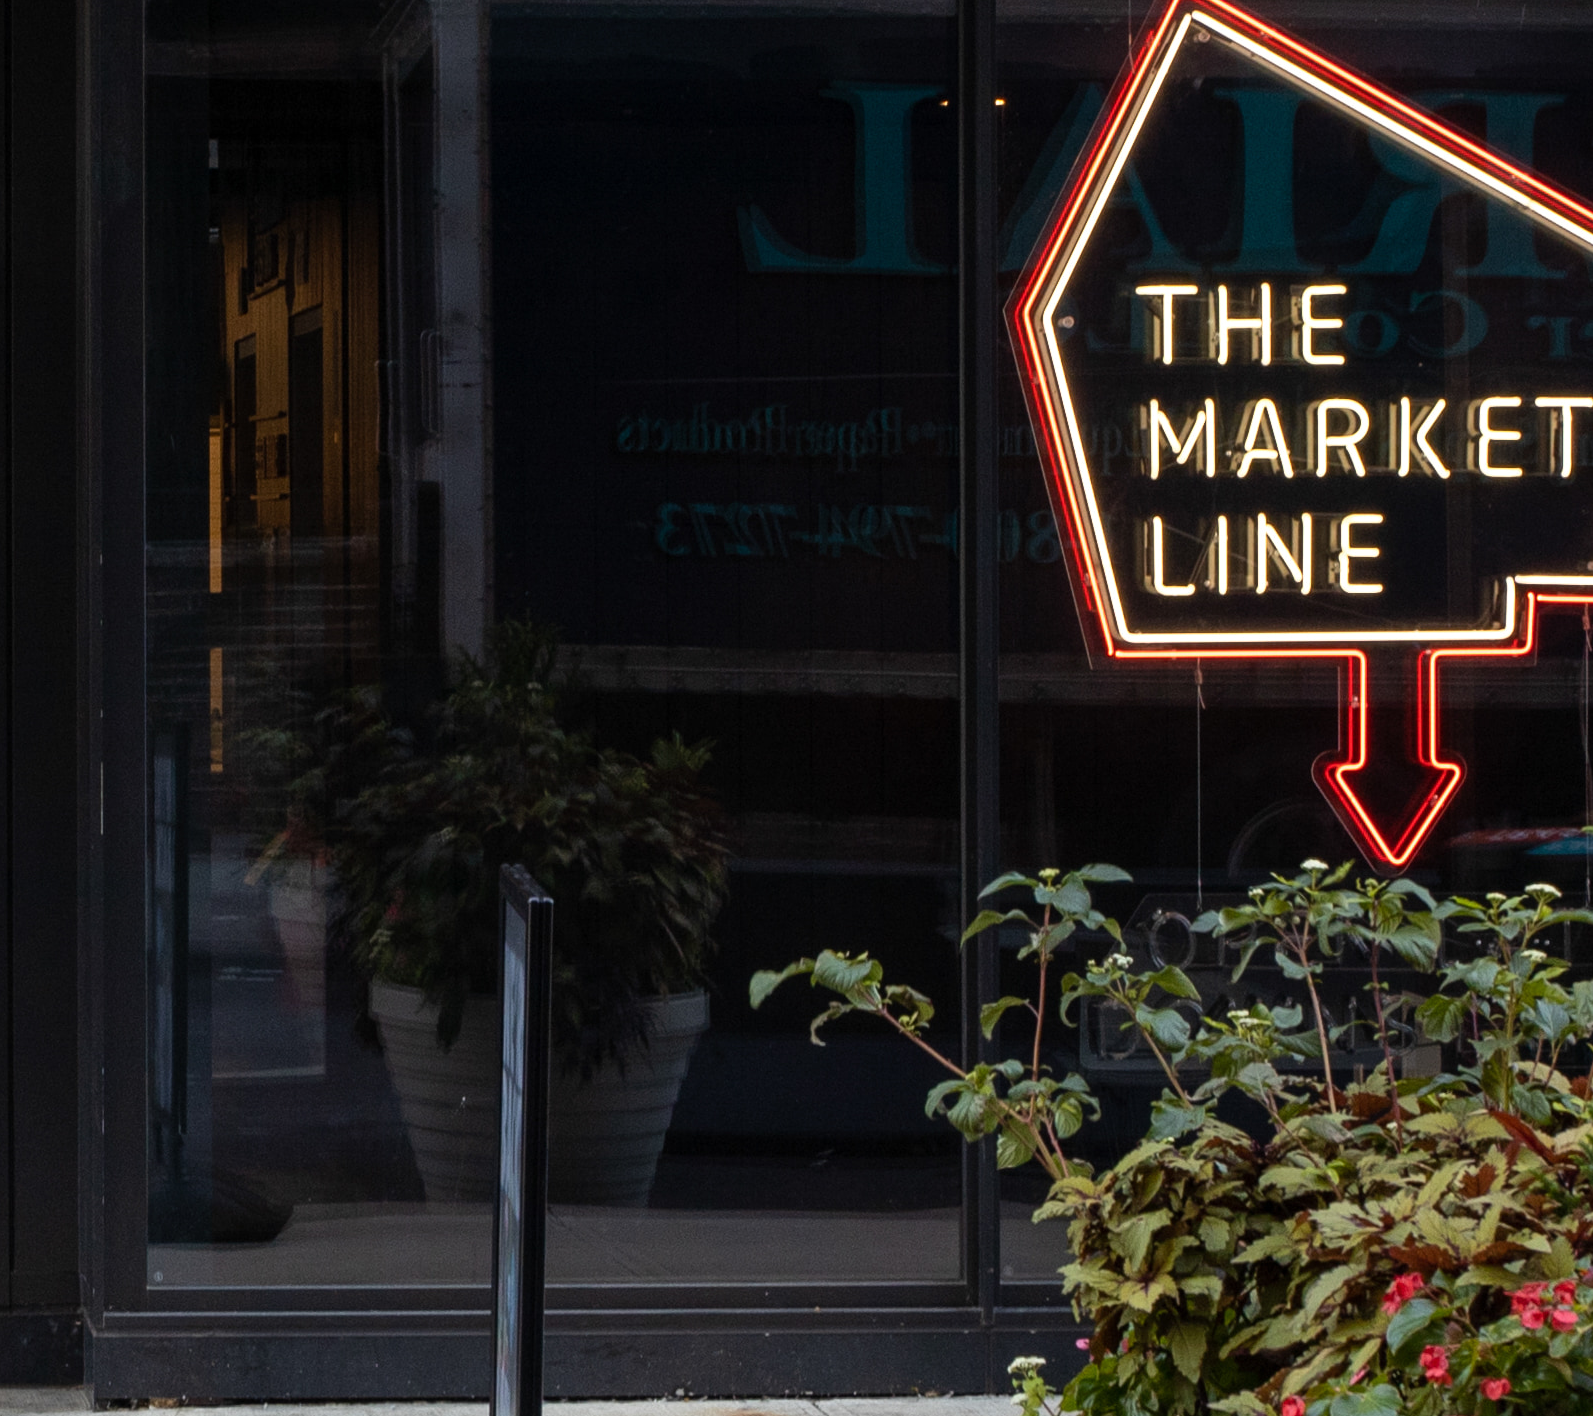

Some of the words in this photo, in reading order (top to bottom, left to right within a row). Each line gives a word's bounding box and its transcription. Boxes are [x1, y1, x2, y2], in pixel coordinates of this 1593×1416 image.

[1136, 283, 1346, 365] THE
[1151, 397, 1593, 479] MARKET
[1153, 513, 1383, 595] LINE
